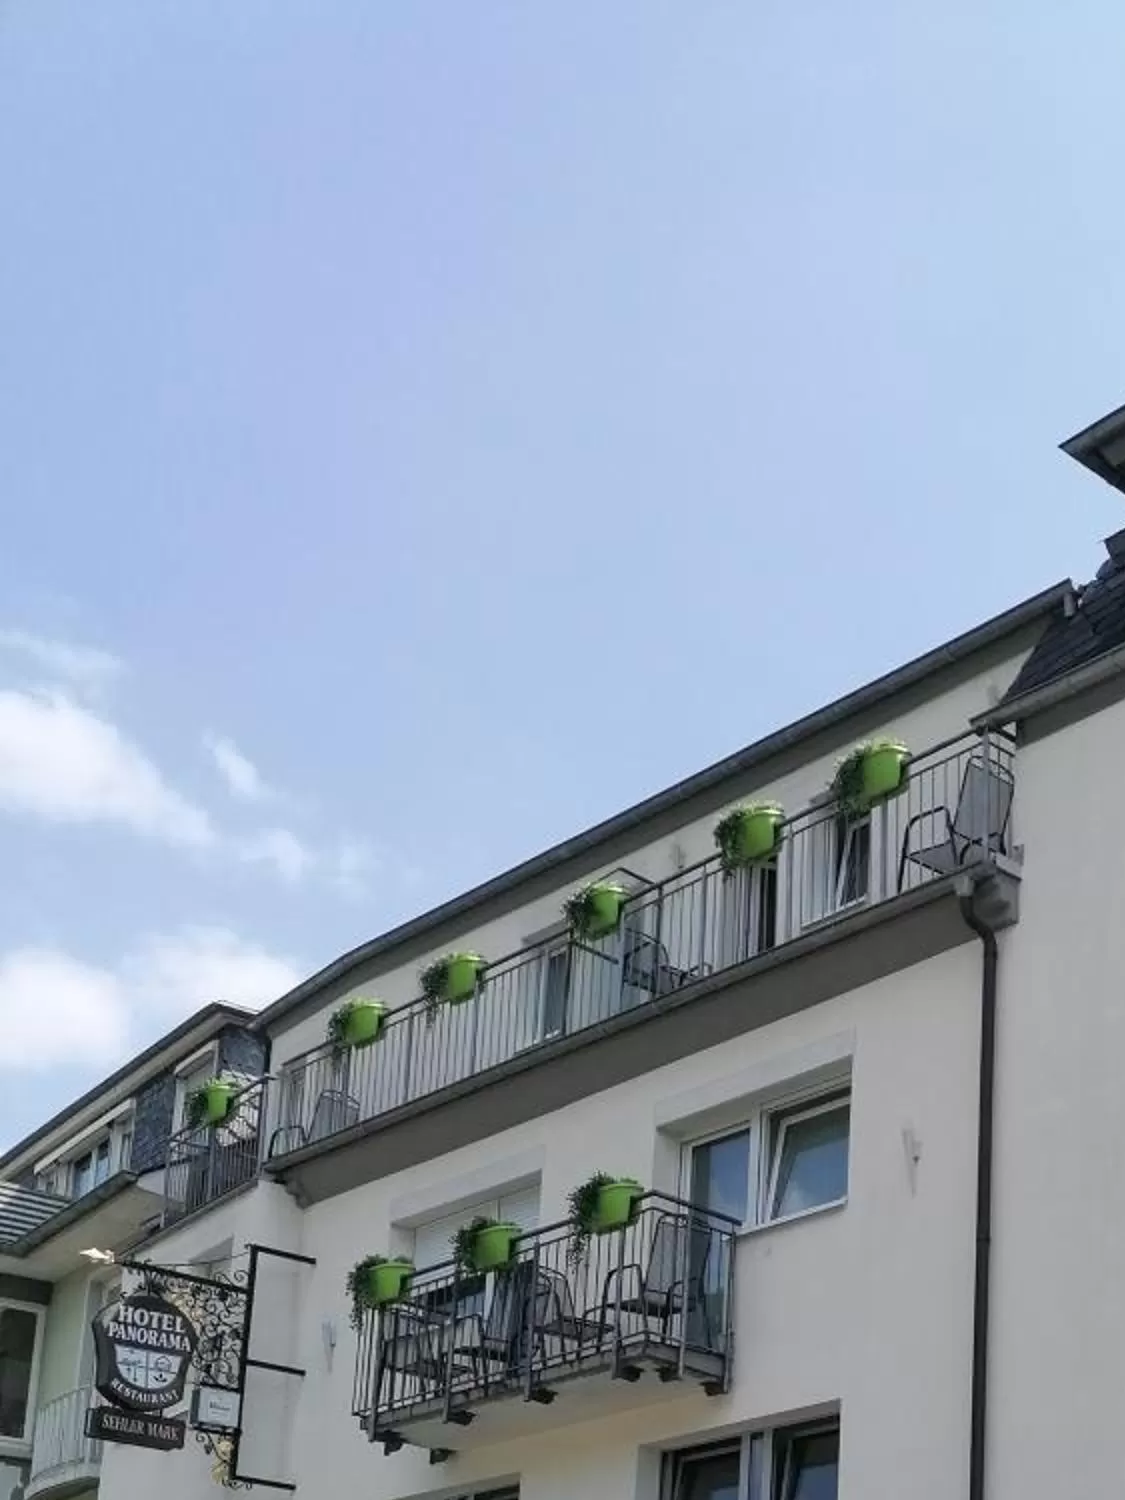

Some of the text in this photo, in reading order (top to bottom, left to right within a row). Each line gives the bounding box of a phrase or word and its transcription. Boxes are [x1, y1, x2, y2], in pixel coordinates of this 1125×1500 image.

[119, 1304, 185, 1333] HOTEL
[108, 1321, 191, 1351] PANORAMA
[111, 1378, 179, 1403] RESTAURANT
